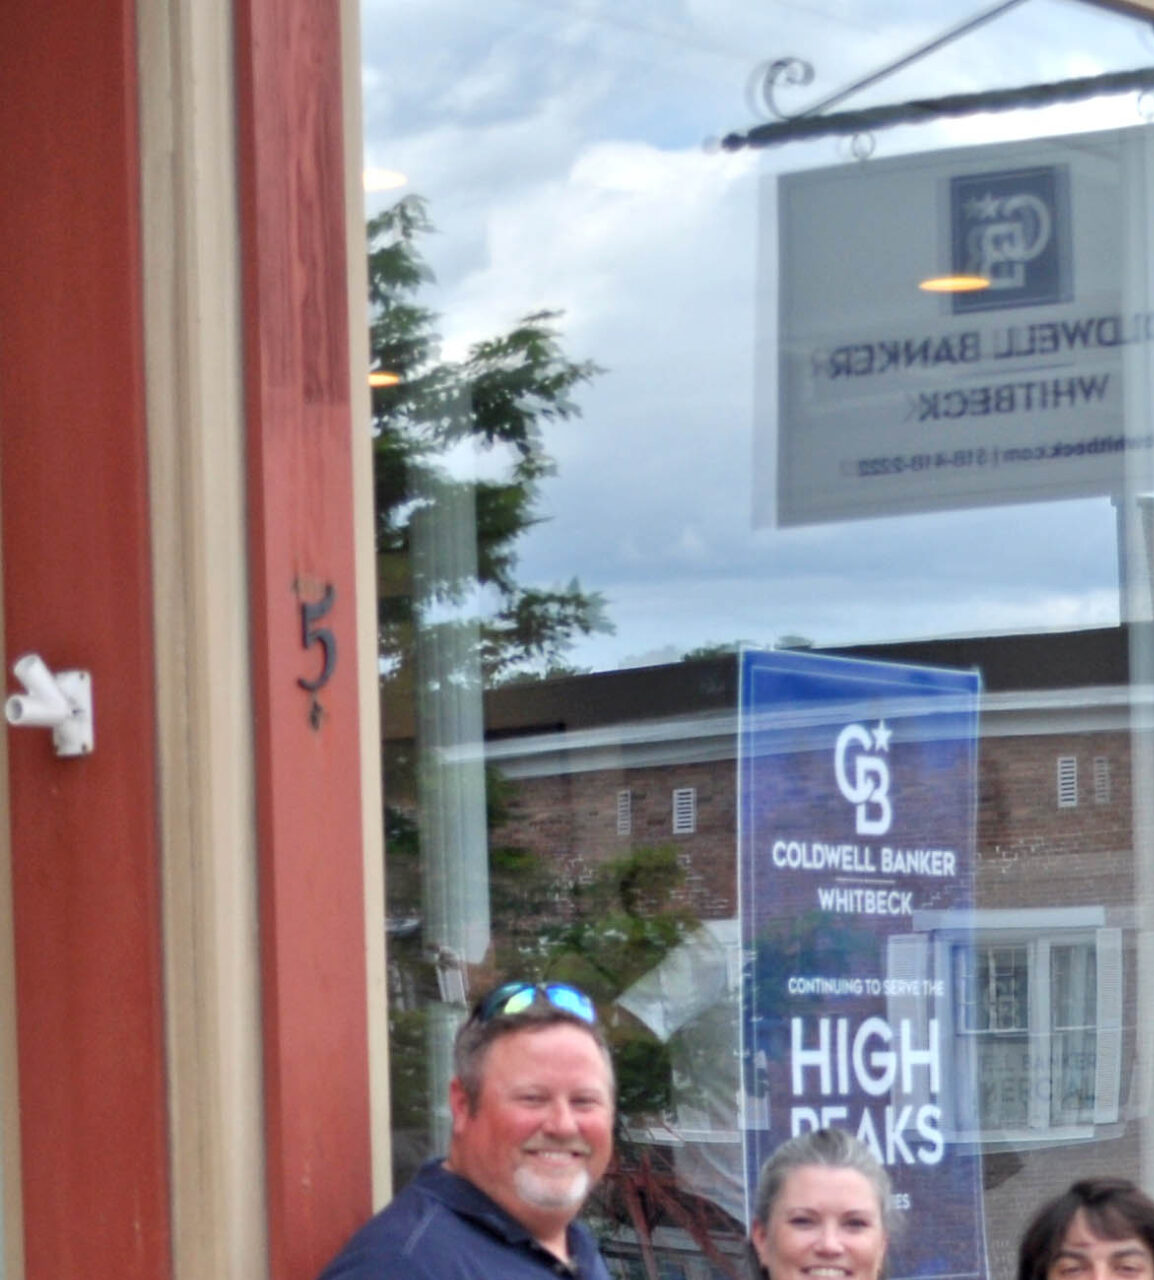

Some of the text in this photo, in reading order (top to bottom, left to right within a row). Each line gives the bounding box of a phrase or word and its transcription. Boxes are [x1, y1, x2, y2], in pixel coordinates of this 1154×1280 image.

[772, 841, 956, 876] COLDWELL BANKER
[818, 887, 913, 915] WHITBECK
[788, 977, 944, 996] CONTINUING TO SERVE THE
[791, 1017, 940, 1096] HIGH
